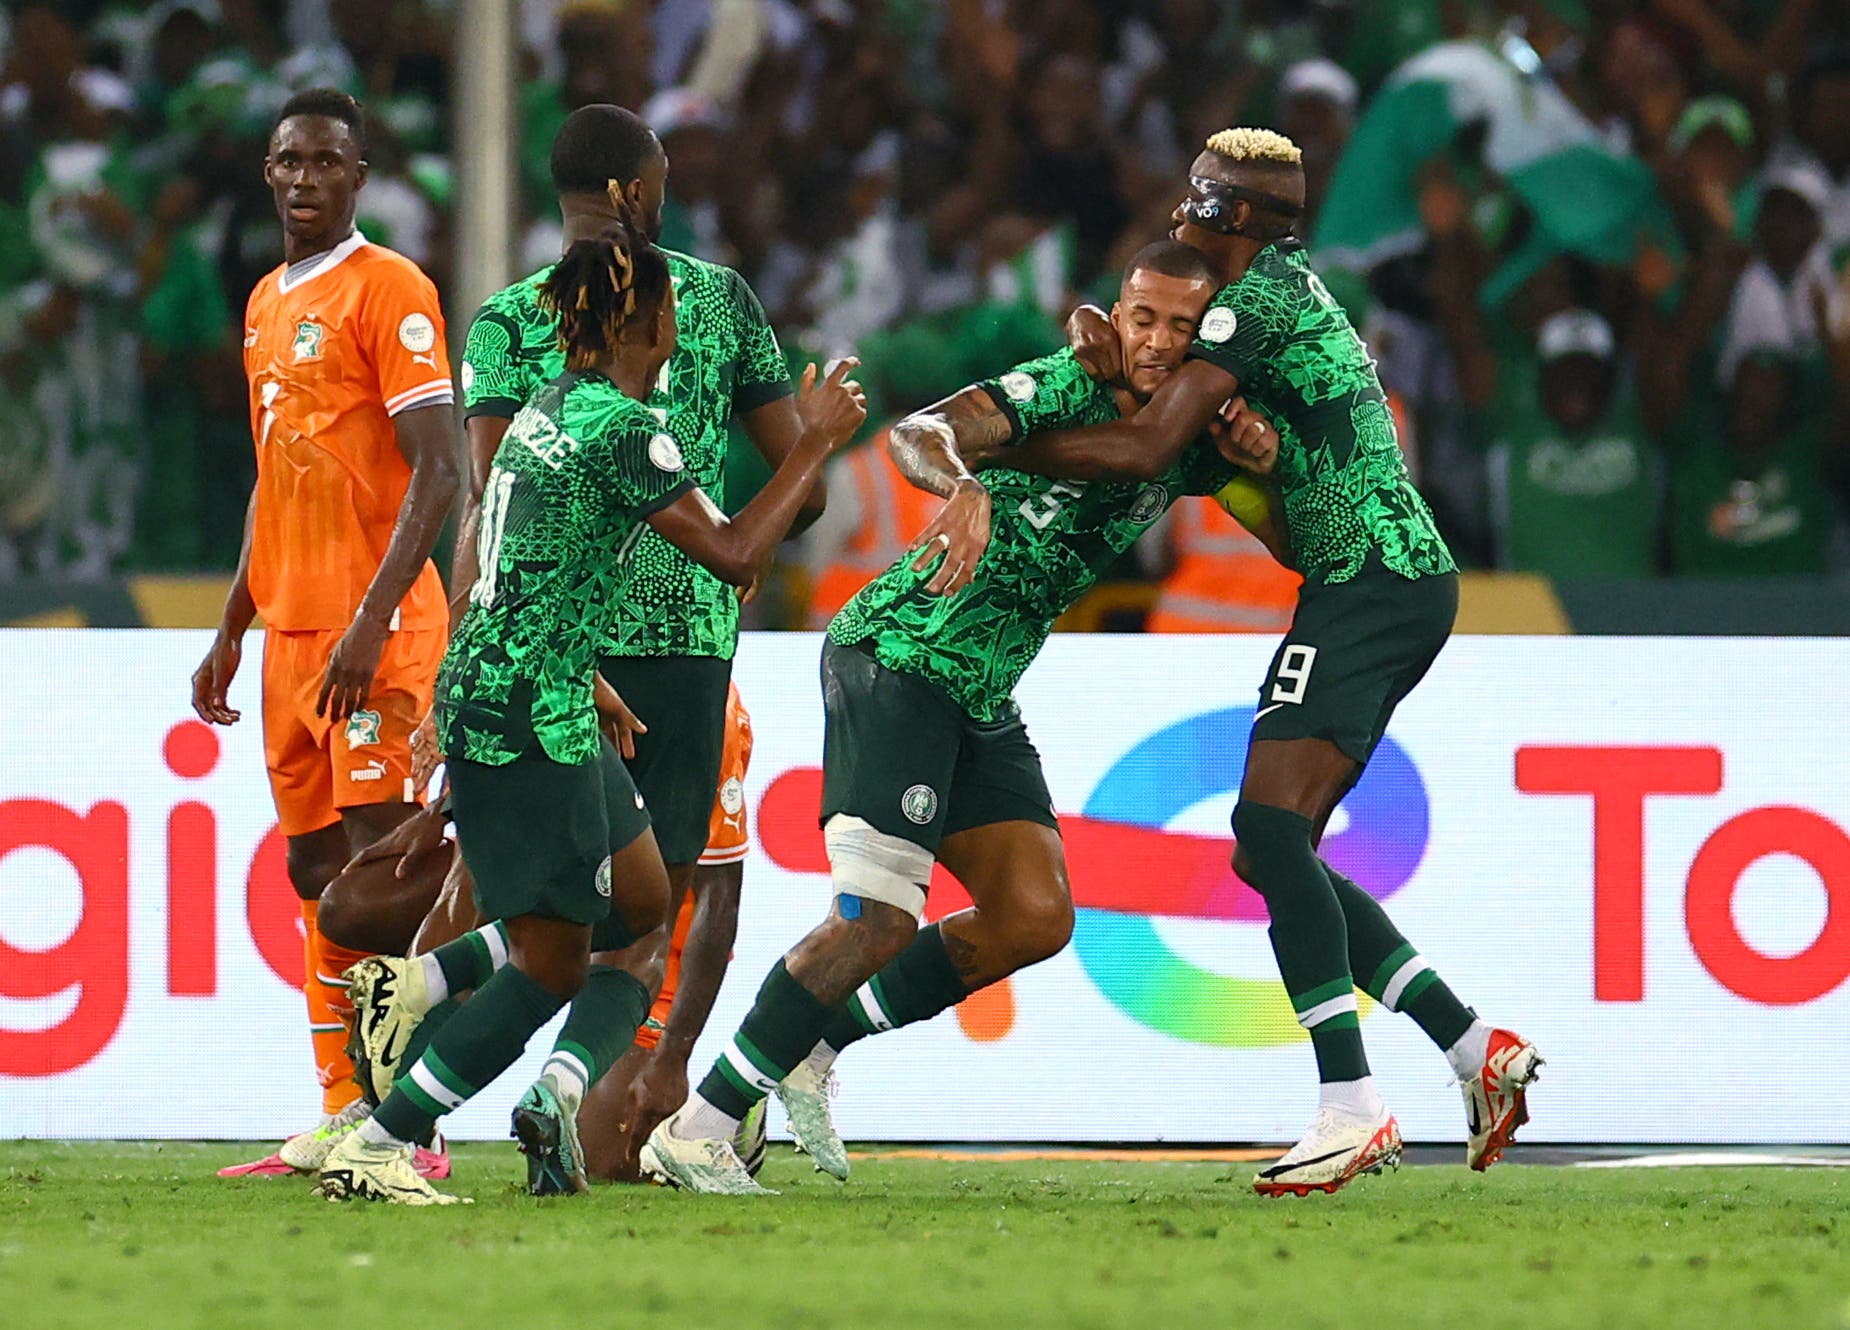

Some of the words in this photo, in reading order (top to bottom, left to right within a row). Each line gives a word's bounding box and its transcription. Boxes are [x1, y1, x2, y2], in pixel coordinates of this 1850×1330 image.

[1196, 206, 1219, 218] VO9
[1271, 644, 1318, 705] 9
[1514, 746, 1850, 1007] To
